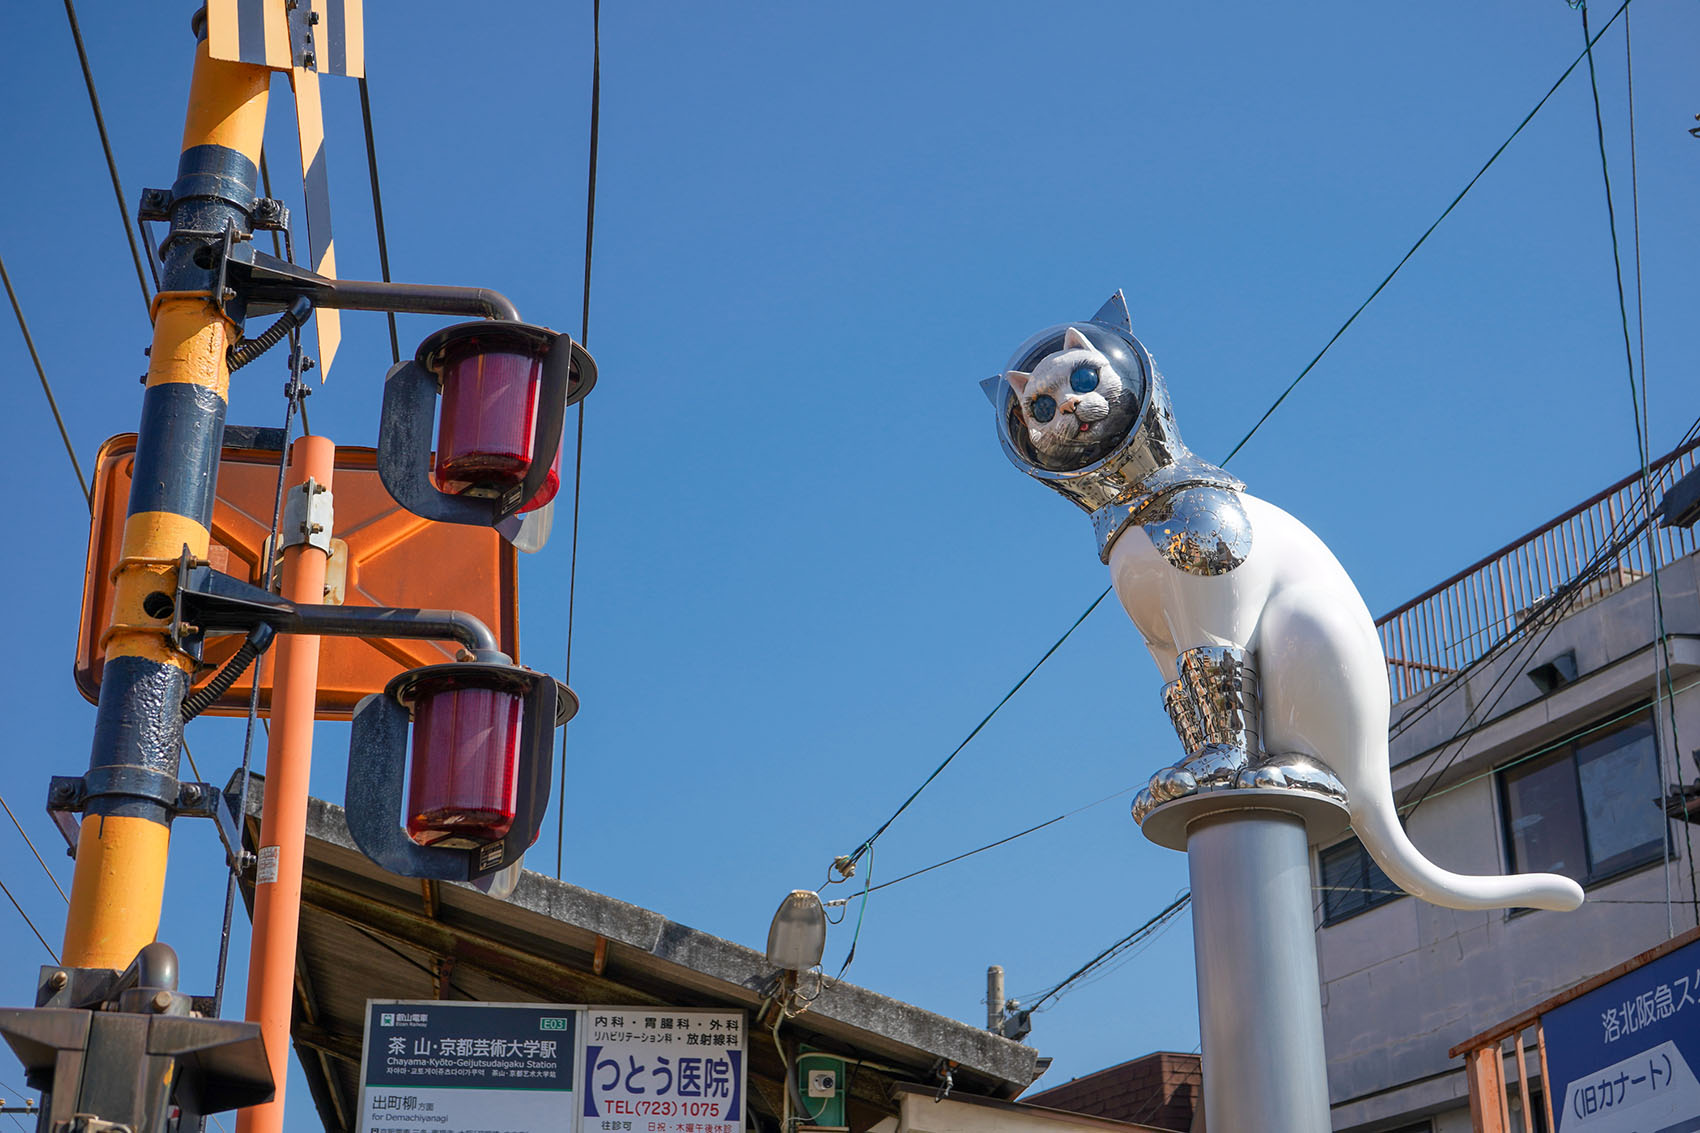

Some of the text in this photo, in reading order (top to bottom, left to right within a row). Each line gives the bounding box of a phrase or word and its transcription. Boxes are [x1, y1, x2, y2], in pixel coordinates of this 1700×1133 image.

[544, 1019, 563, 1029] E03
[527, 1061, 557, 1069] Station
[597, 1055, 729, 1098] つとう医院
[372, 1113, 449, 1123] for Demachiyanagi
[601, 1121, 632, 1131] 往診可
